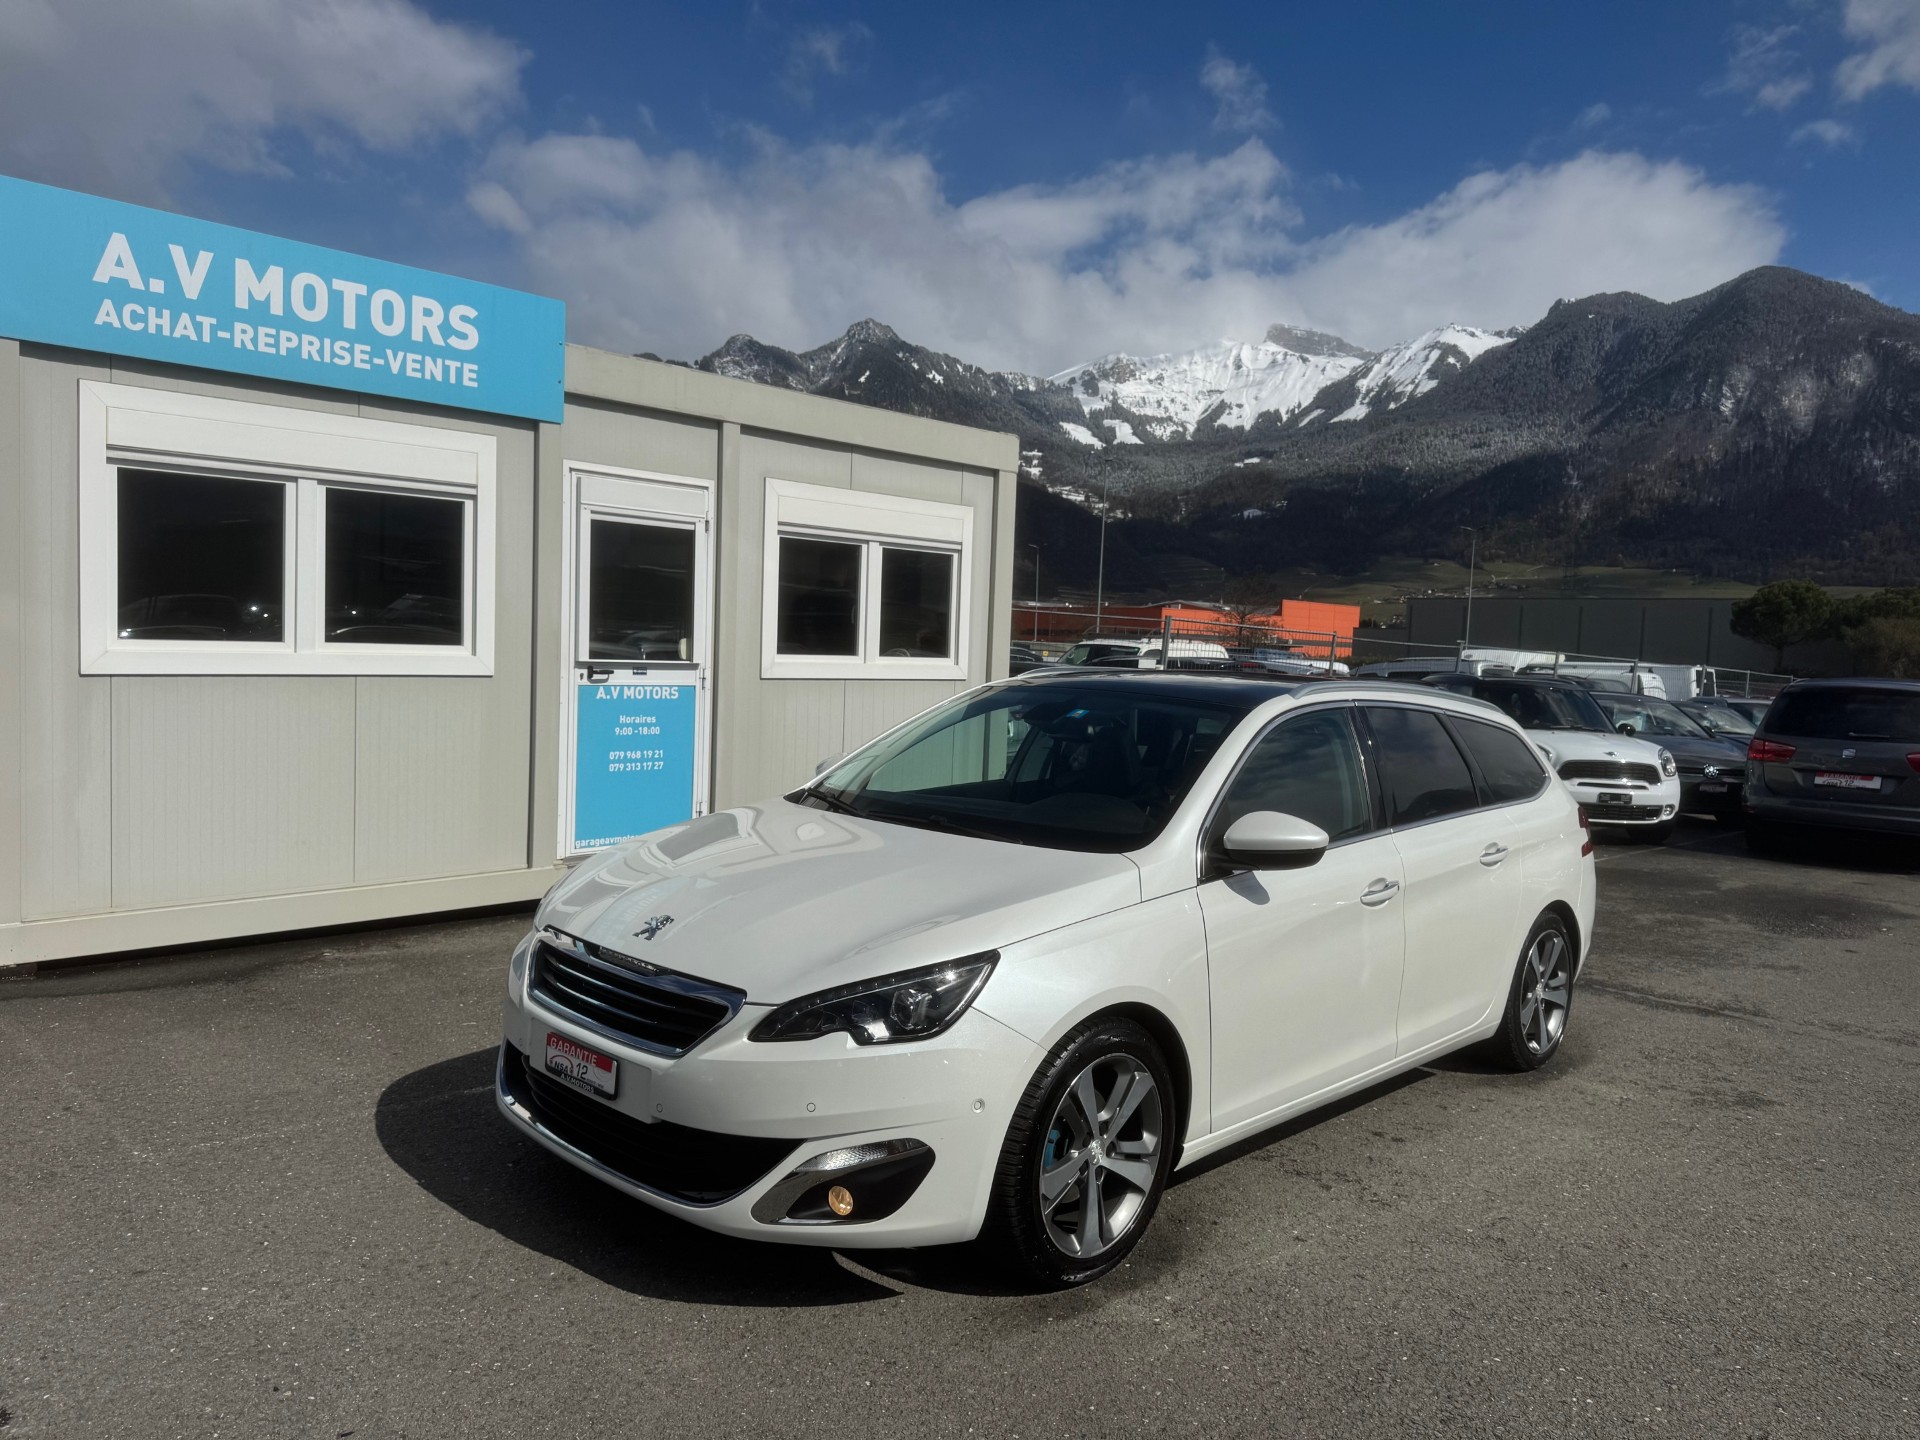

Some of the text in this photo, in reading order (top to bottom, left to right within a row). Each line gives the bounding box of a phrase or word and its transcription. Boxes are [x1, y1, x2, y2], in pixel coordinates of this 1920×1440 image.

[92, 231, 479, 350] A.V MOTORS
[94, 298, 479, 388] ACHAT-REPRISE-VENTE
[596, 686, 679, 699] A.V MOTORS
[619, 715, 656, 723] Horaires
[614, 727, 632, 735] 9:00
[609, 750, 664, 760] 079 968 19 21
[609, 762, 664, 772] 079 313 17 27
[550, 1037, 598, 1066] GARANTIE
[554, 1061, 589, 1081] NSA 12
